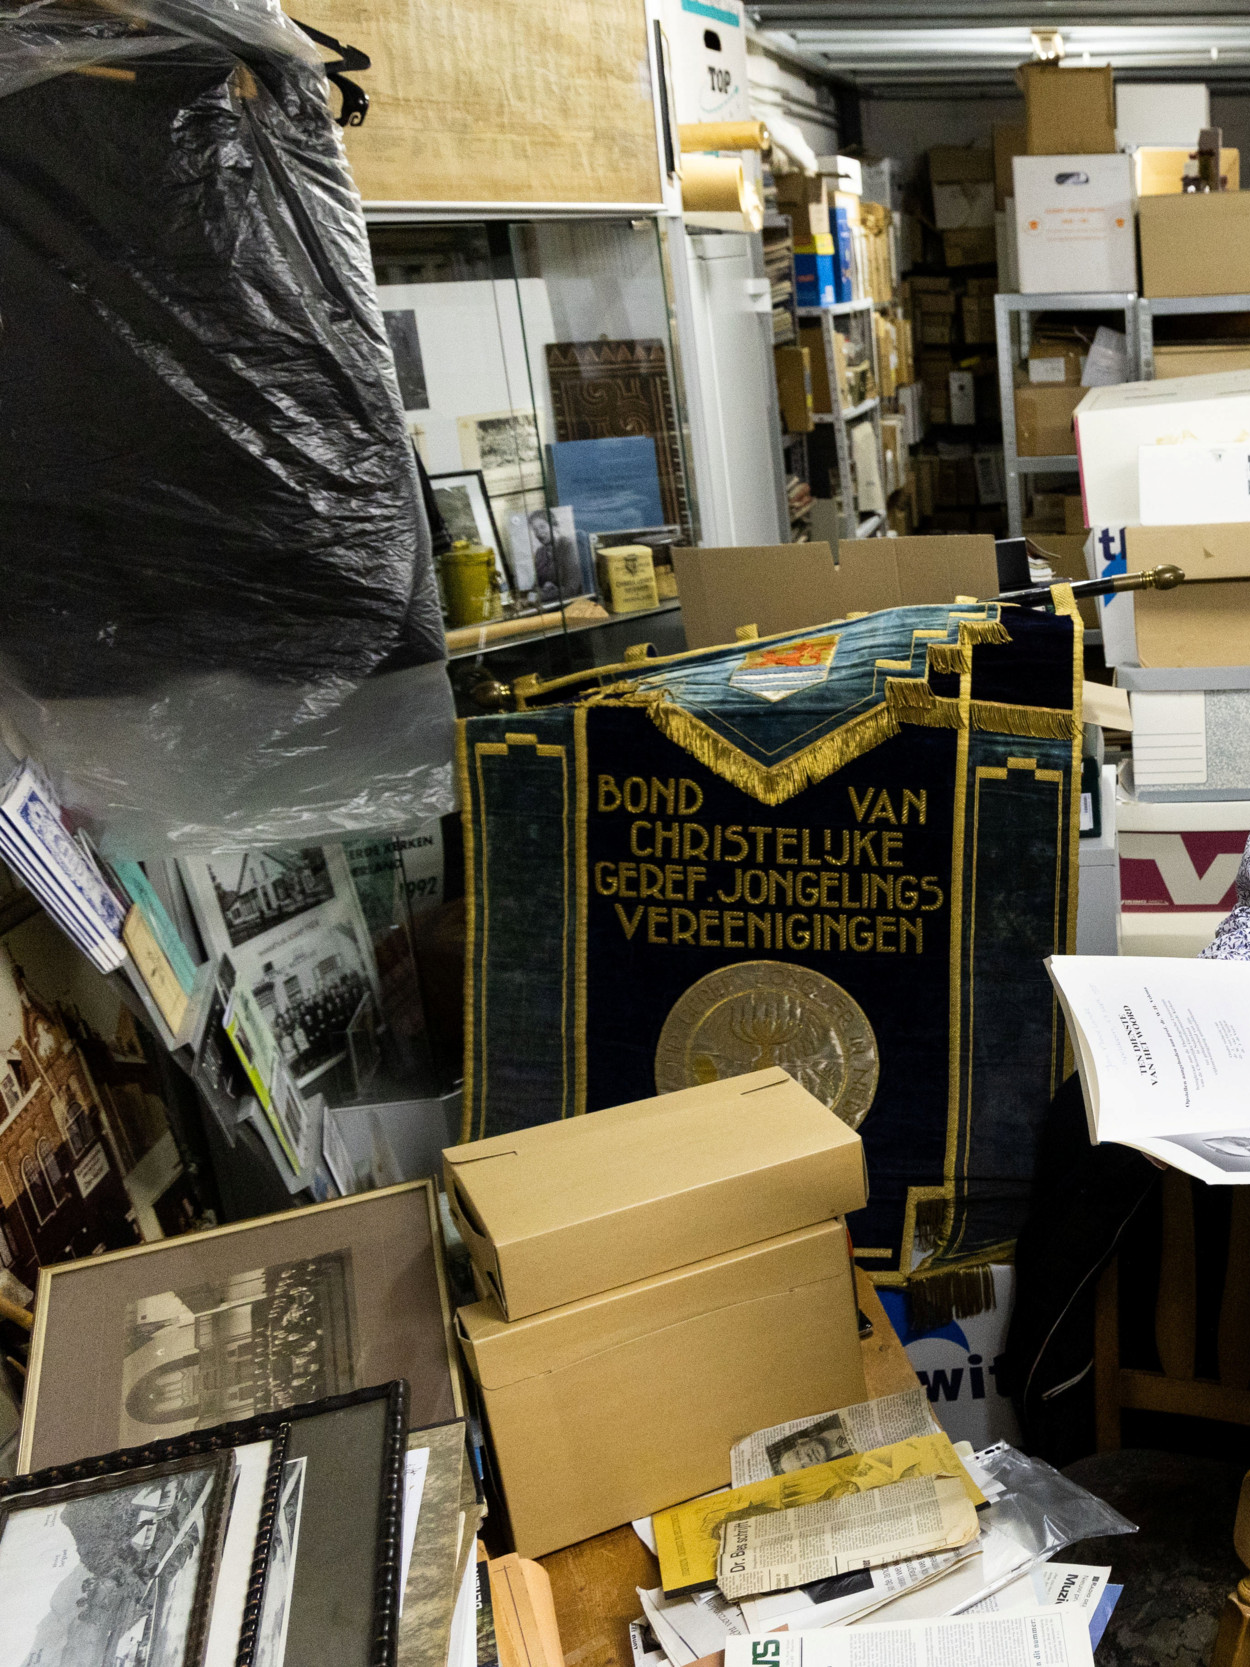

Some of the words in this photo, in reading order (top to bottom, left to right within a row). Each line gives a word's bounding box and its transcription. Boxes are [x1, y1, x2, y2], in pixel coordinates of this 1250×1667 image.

[708, 65, 732, 94] TOP
[597, 774, 704, 816] BOND
[847, 786, 927, 825] VAN
[630, 820, 904, 868] CHRISTELIJKE
[717, 868, 944, 912] JONGELINGS
[613, 903, 924, 954] VEREENIGINGEN
[1118, 1014, 1141, 1052] DIENSTE
[1123, 1005, 1143, 1038] WOORD
[1138, 1055, 1148, 1076] TEN
[1140, 1042, 1152, 1060] HET
[1148, 1063, 1158, 1086] VAN
[730, 1558, 746, 1573] Dr.
